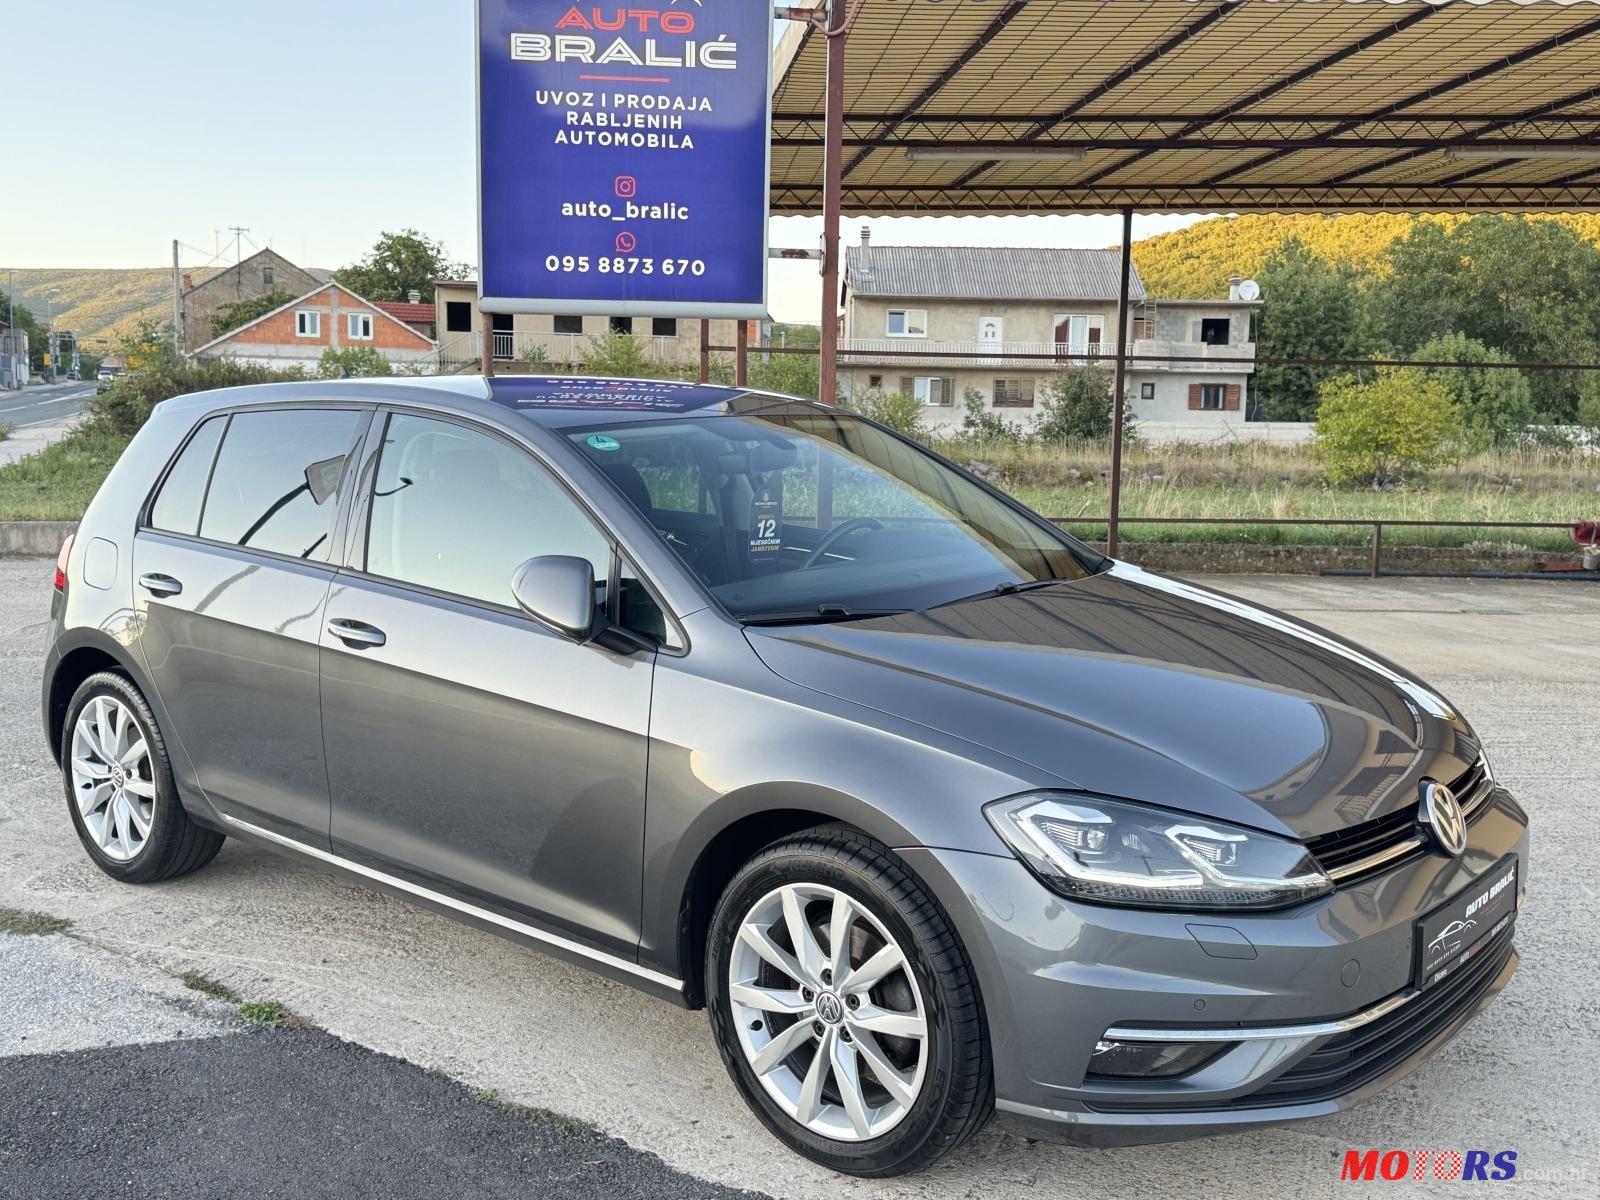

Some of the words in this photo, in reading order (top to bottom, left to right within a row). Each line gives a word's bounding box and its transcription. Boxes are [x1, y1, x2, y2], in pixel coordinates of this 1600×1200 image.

[555, 6, 695, 33] AUTO
[510, 33, 737, 69] BRALIĆ
[535, 90, 594, 107] UVOZ
[601, 93, 606, 108] I
[614, 94, 712, 111] PRODAJA
[566, 111, 682, 129] RABLJENIH
[555, 131, 694, 149] AUTOMOBILA
[561, 201, 689, 221] auto_bralic
[545, 255, 590, 272] 095
[598, 258, 654, 275] 8873
[661, 259, 705, 276] 670
[757, 519, 776, 538] 12
[1465, 891, 1489, 918] AUTO
